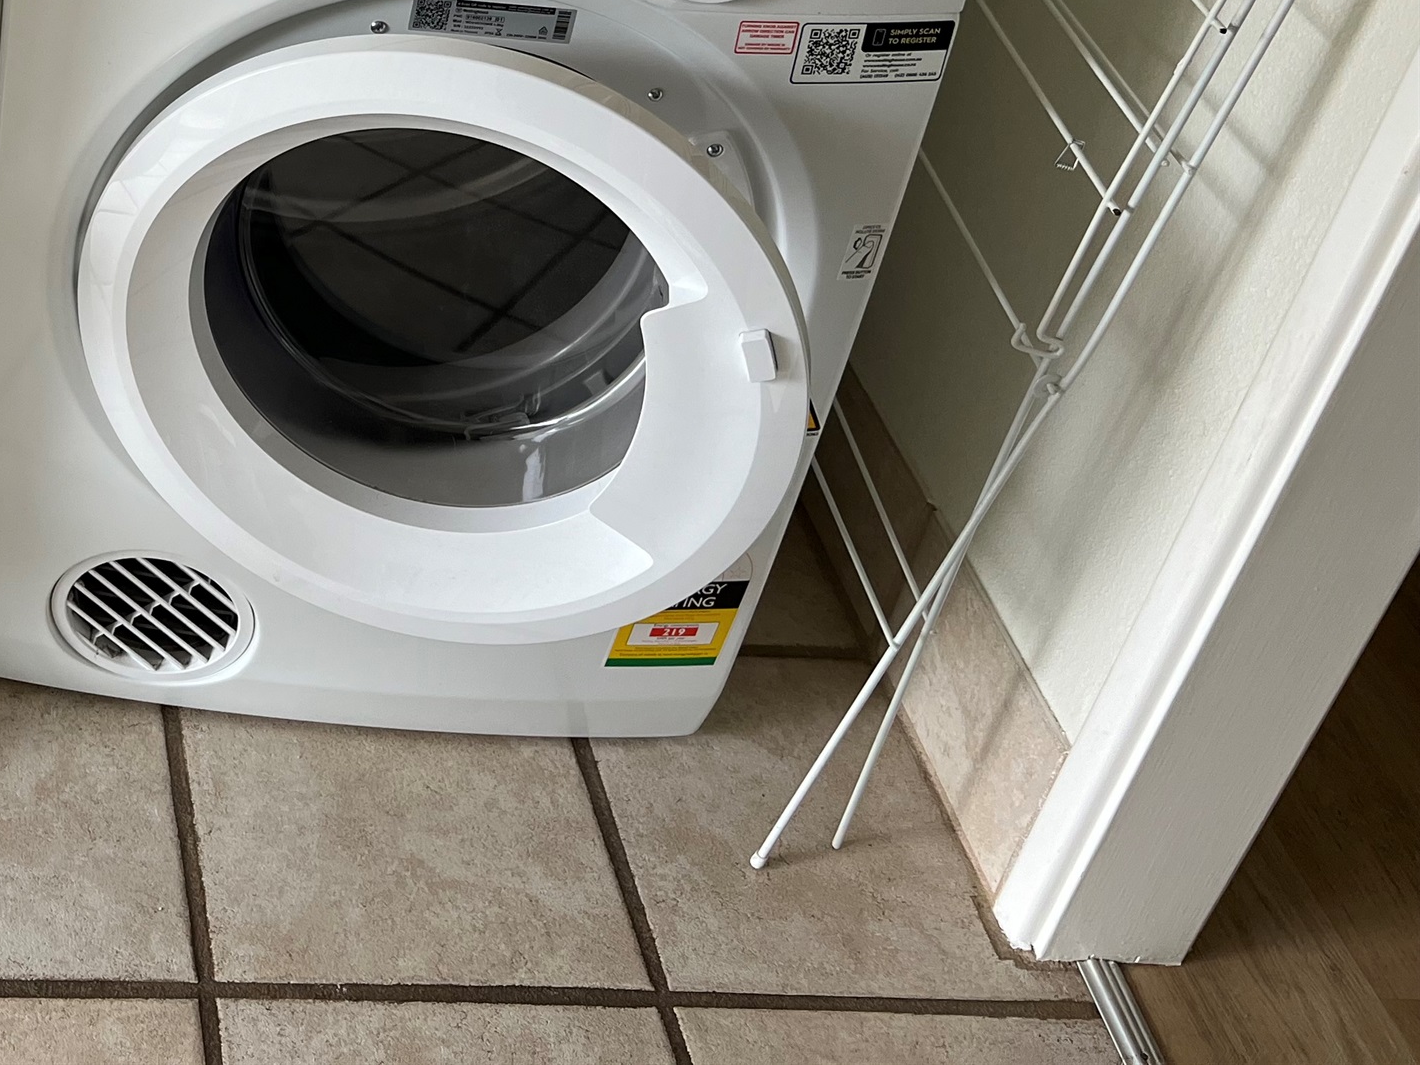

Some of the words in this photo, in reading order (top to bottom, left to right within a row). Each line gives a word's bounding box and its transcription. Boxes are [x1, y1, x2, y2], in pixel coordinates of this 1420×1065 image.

[890, 28, 917, 36] SIMPLY
[919, 27, 941, 35] SCAN
[901, 36, 937, 44] REGISTER
[662, 628, 686, 636] 219
